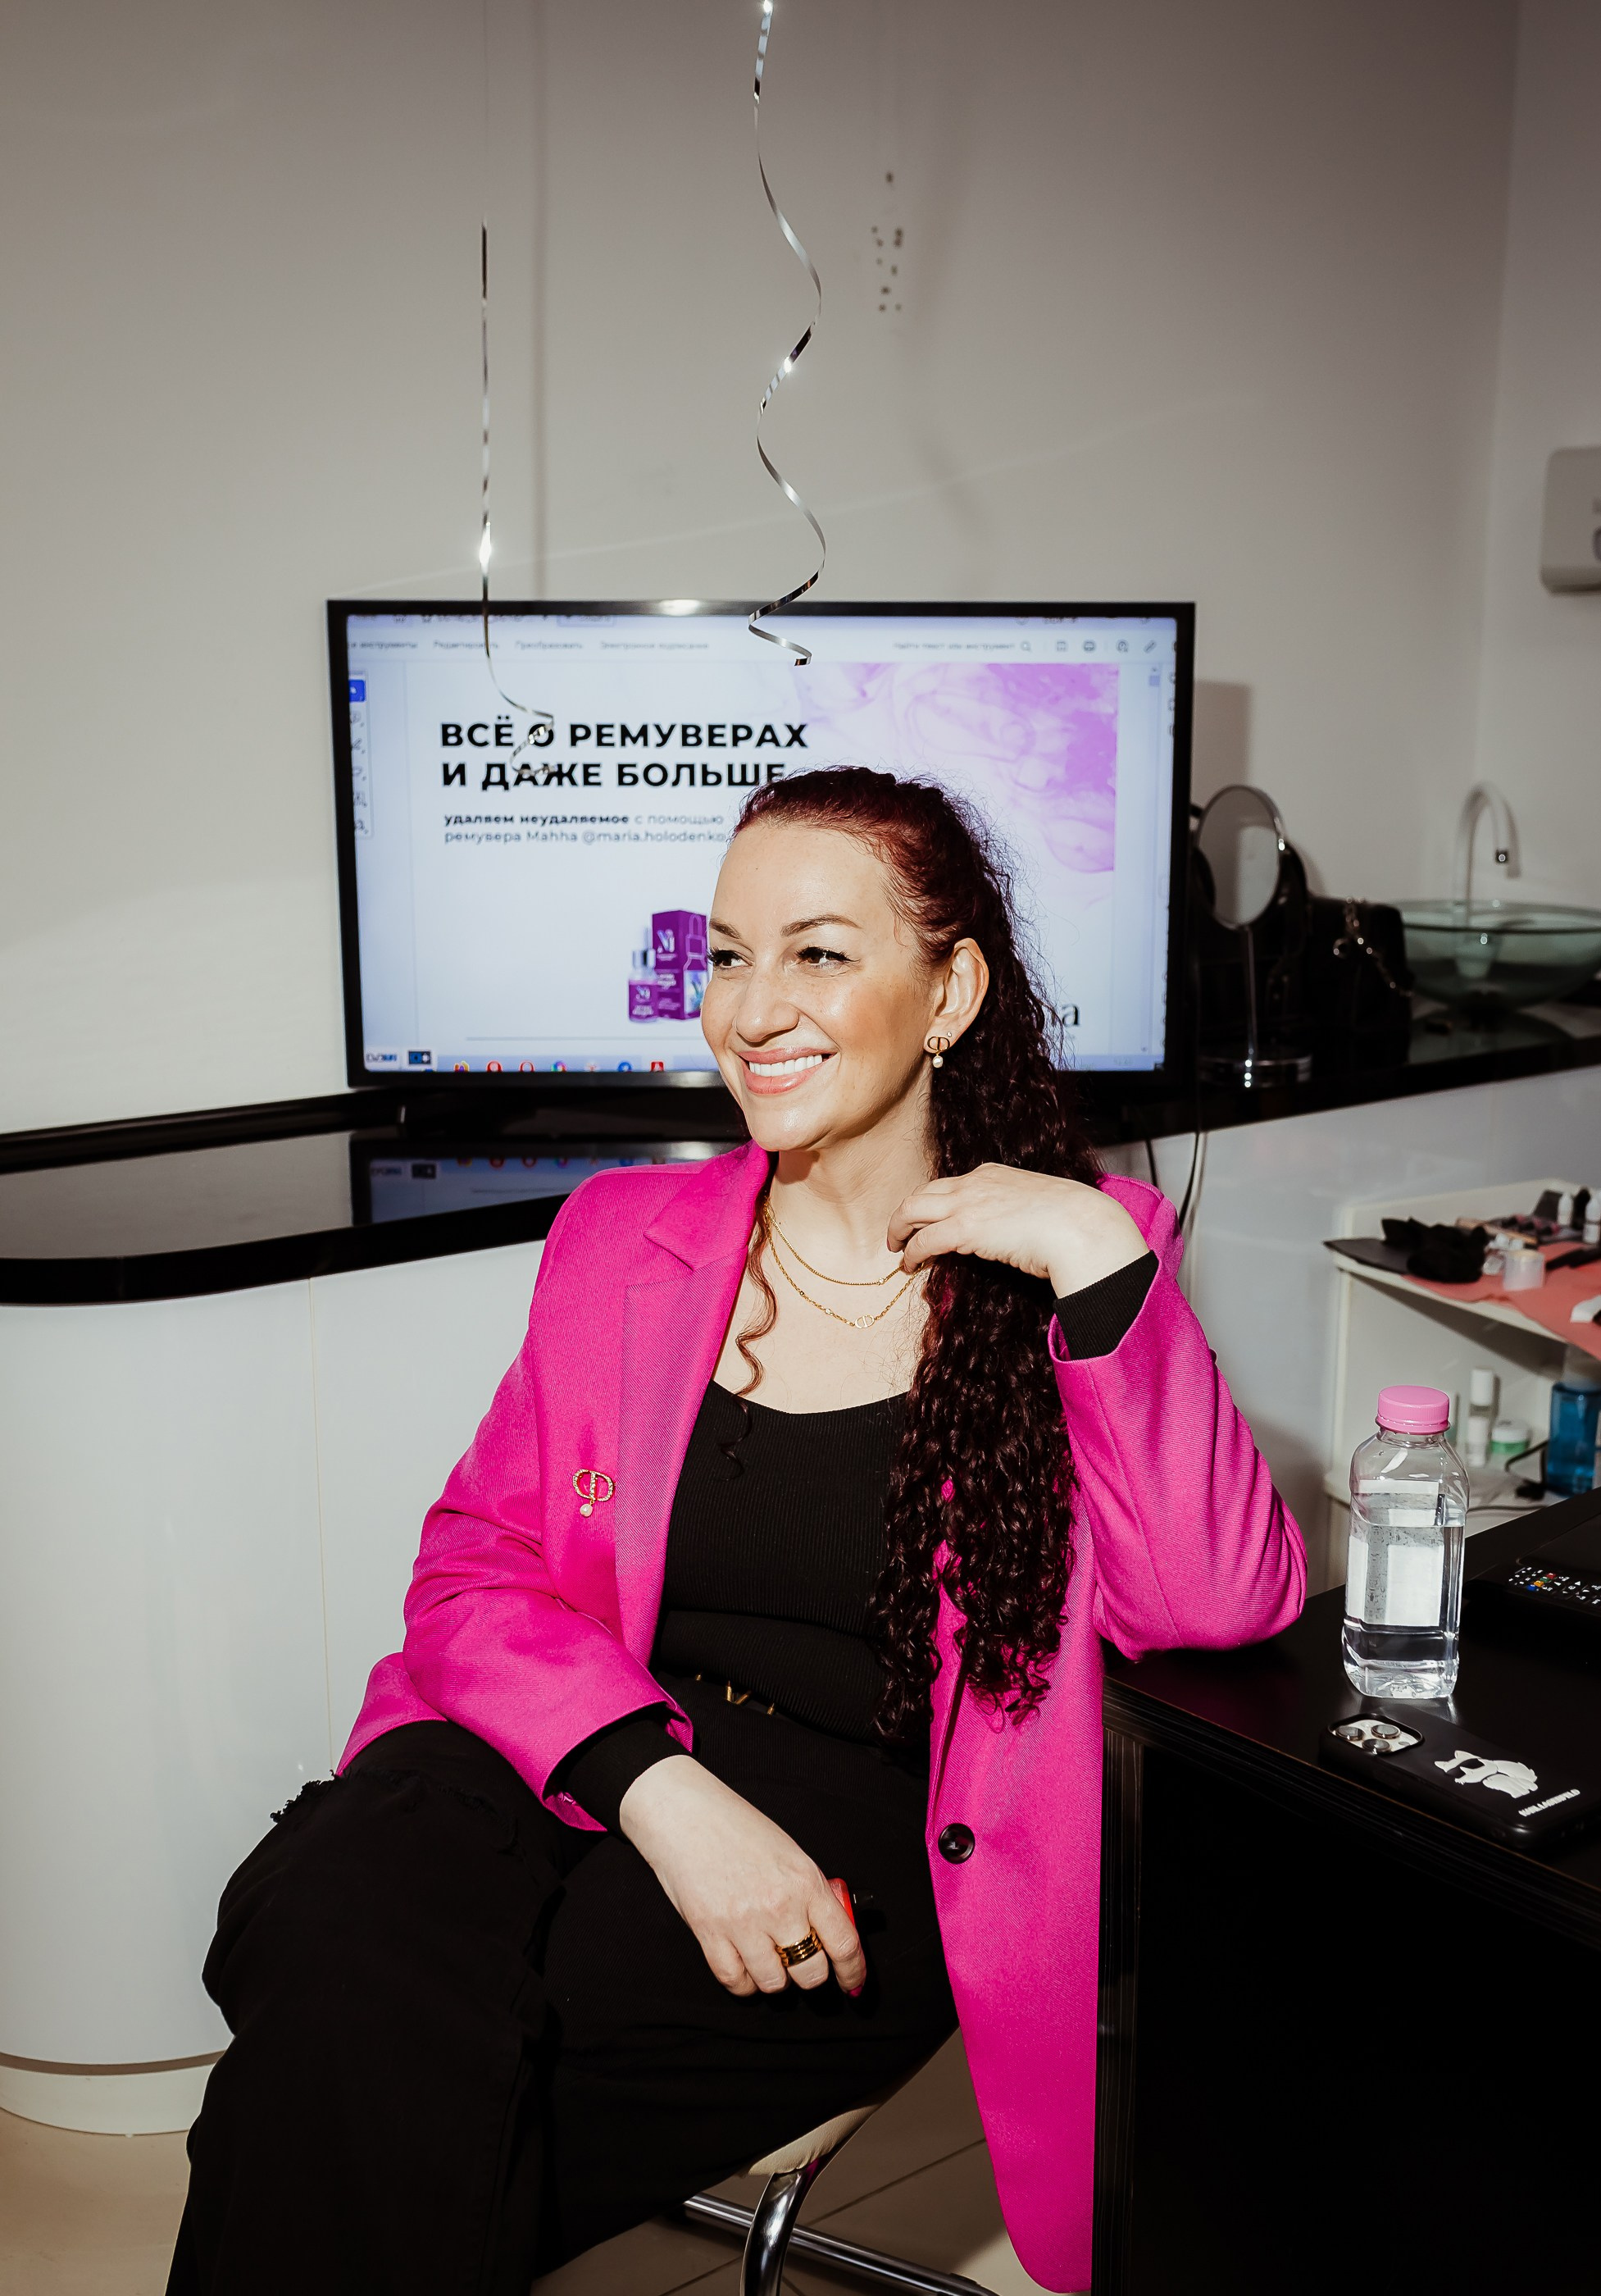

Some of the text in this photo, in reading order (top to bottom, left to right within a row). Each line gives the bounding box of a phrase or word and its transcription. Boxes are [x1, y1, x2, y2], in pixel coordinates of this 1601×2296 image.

[441, 715, 808, 747] ВСЁ О РЕМУВЕРАХ
[442, 763, 785, 791] И ДАЖЕ БОЛЬШЕ
[444, 814, 724, 827] удаляем неудаляемое с помощью
[445, 831, 521, 845] ремувера
